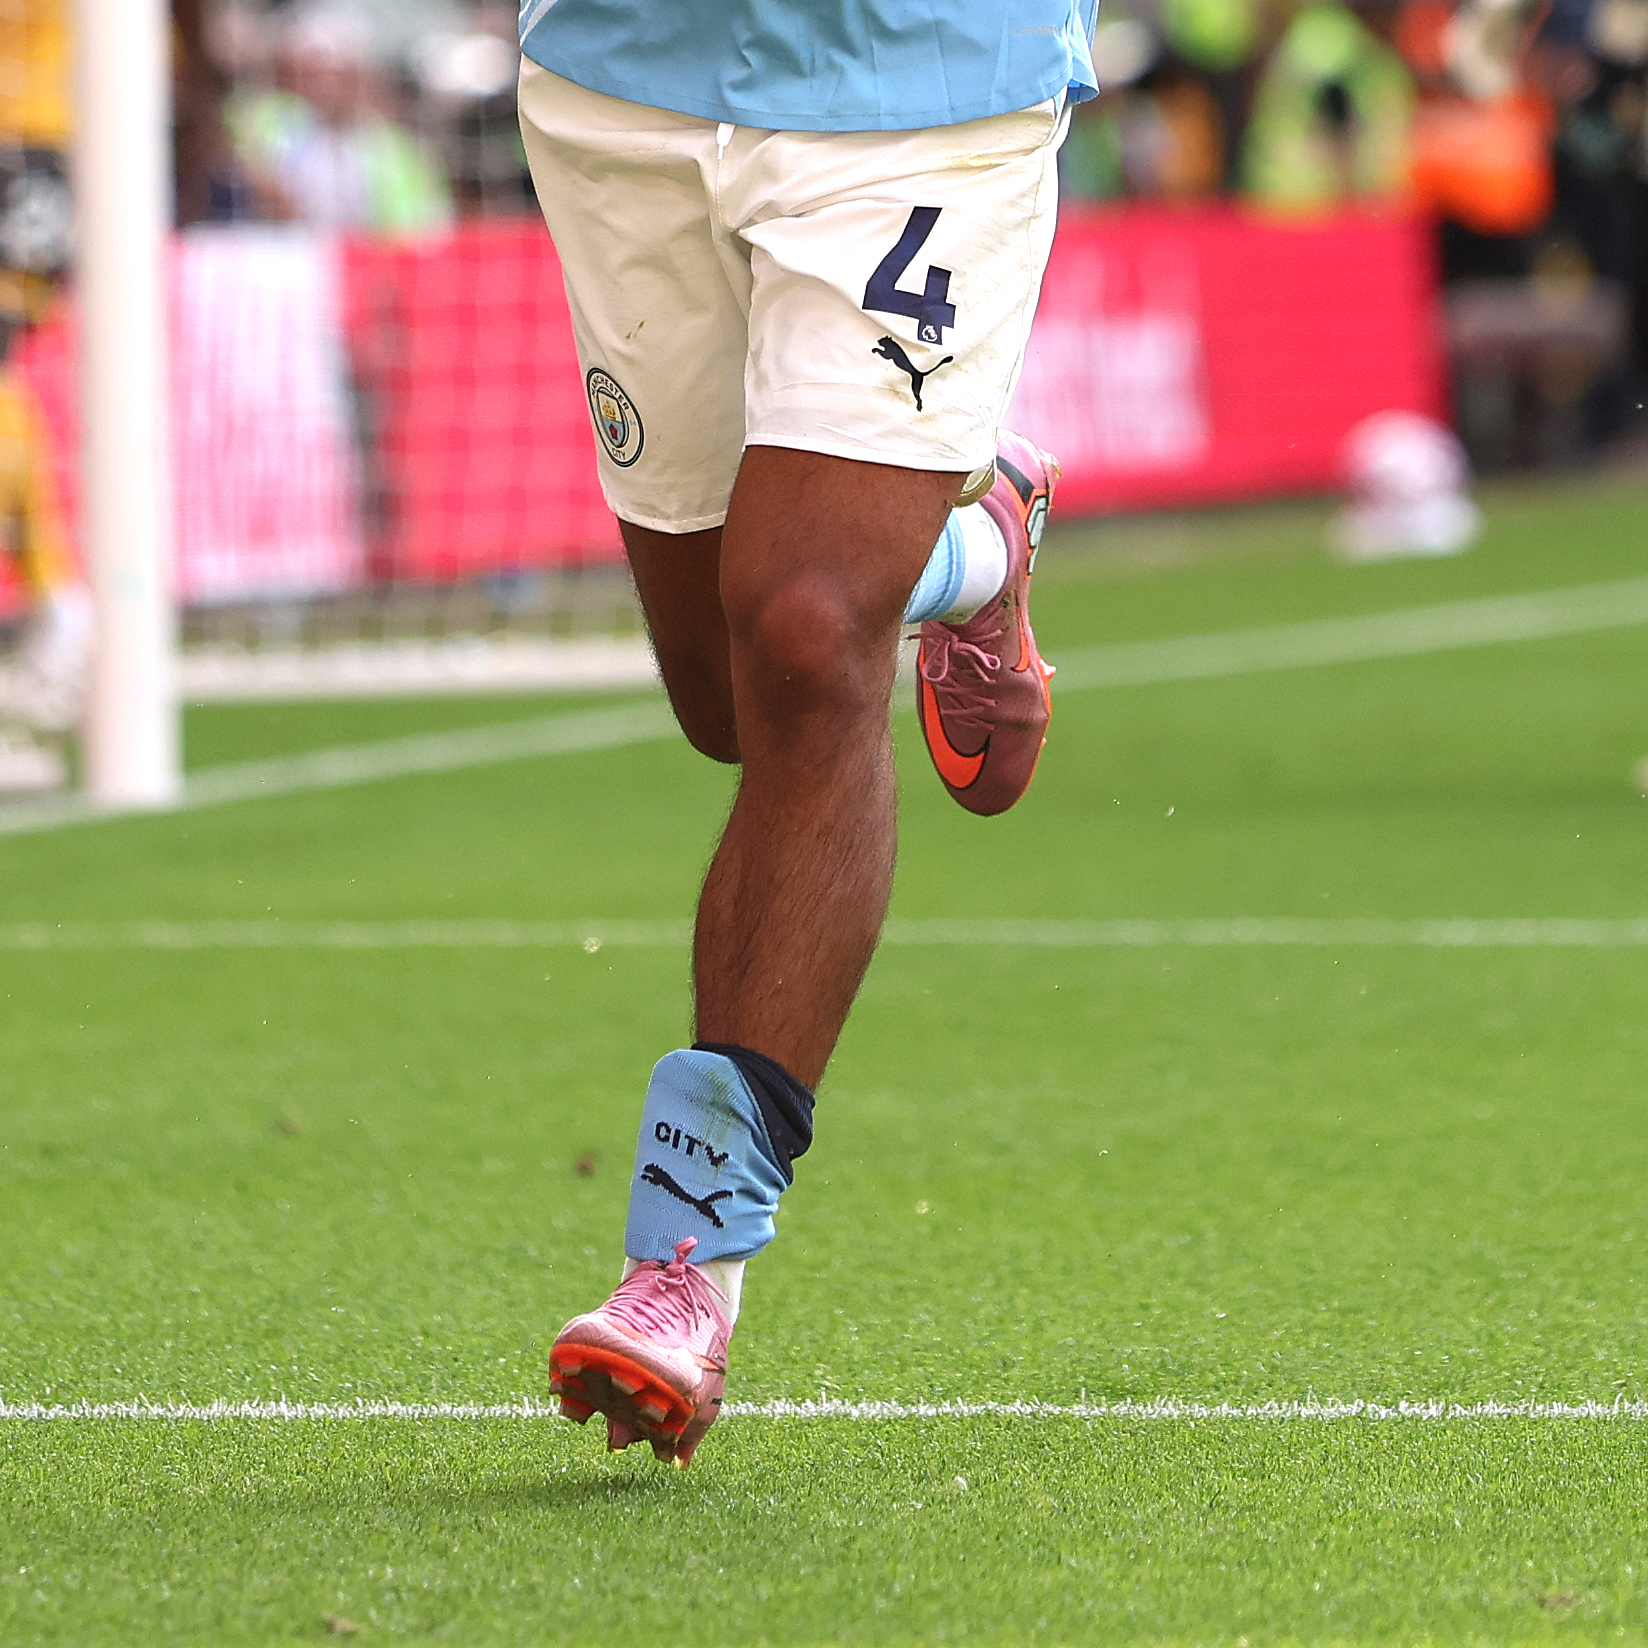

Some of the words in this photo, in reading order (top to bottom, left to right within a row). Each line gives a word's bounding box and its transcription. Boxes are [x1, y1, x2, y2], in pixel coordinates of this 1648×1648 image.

[862, 205, 956, 345] 4
[612, 447, 626, 460] CITY
[654, 1121, 729, 1168] CITY
